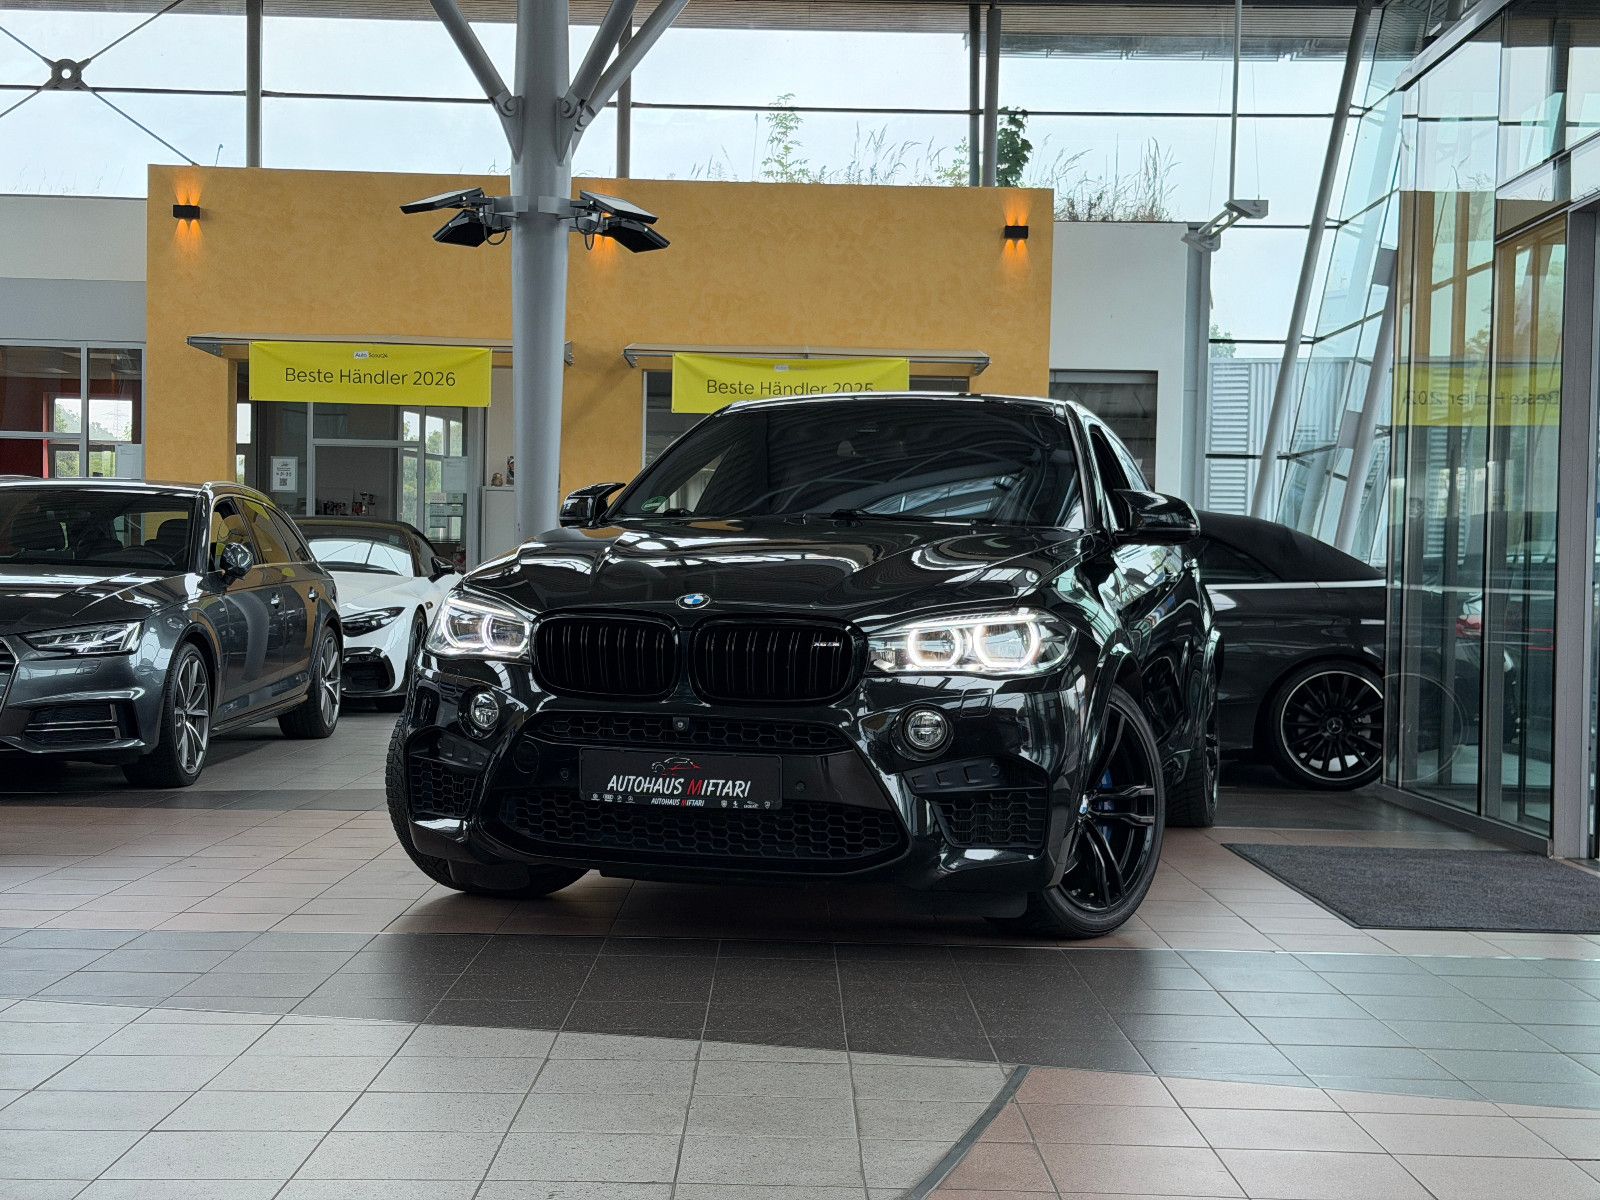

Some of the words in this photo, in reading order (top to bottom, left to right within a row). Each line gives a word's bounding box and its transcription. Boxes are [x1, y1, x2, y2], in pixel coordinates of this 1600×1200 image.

[285, 367, 334, 383] Beste
[339, 368, 408, 385] Händler
[412, 370, 456, 387] 2026
[707, 379, 754, 395] Beste
[760, 381, 828, 396] Händler
[607, 774, 684, 795] AUTOHAUS
[686, 778, 752, 798] MIFTARI
[651, 797, 681, 806] AUTOHAUS
